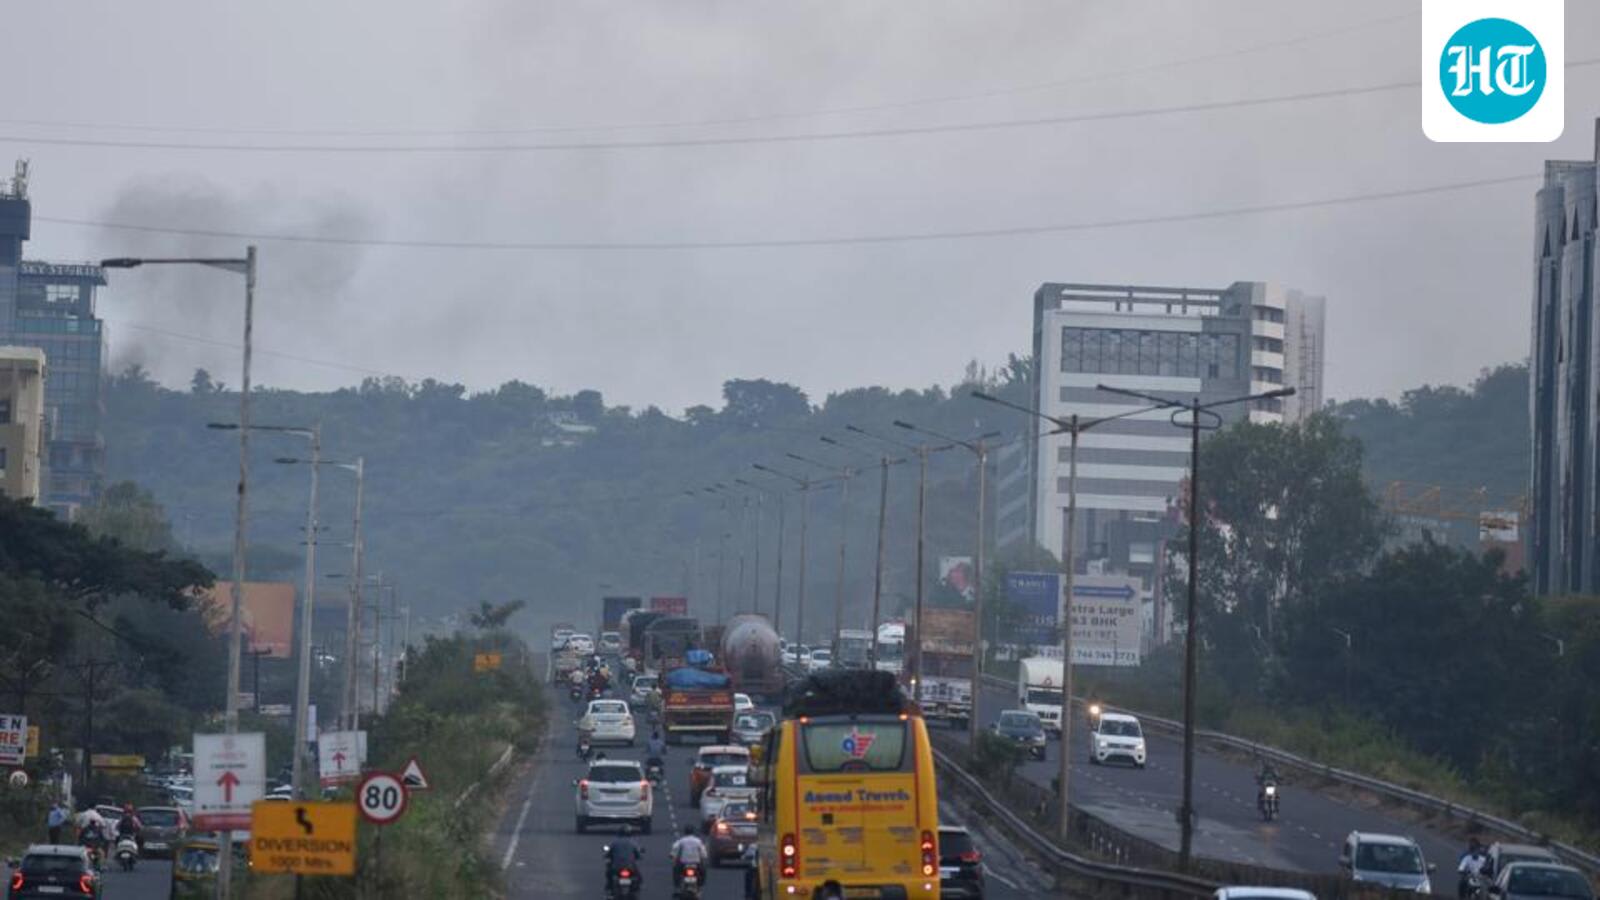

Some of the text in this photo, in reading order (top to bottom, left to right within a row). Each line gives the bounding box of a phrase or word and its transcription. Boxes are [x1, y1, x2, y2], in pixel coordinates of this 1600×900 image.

[1071, 604, 1135, 617] xtra Large
[364, 784, 398, 810] 80
[804, 787, 910, 803] Anand Travels
[256, 839, 351, 853] DIVERSION
